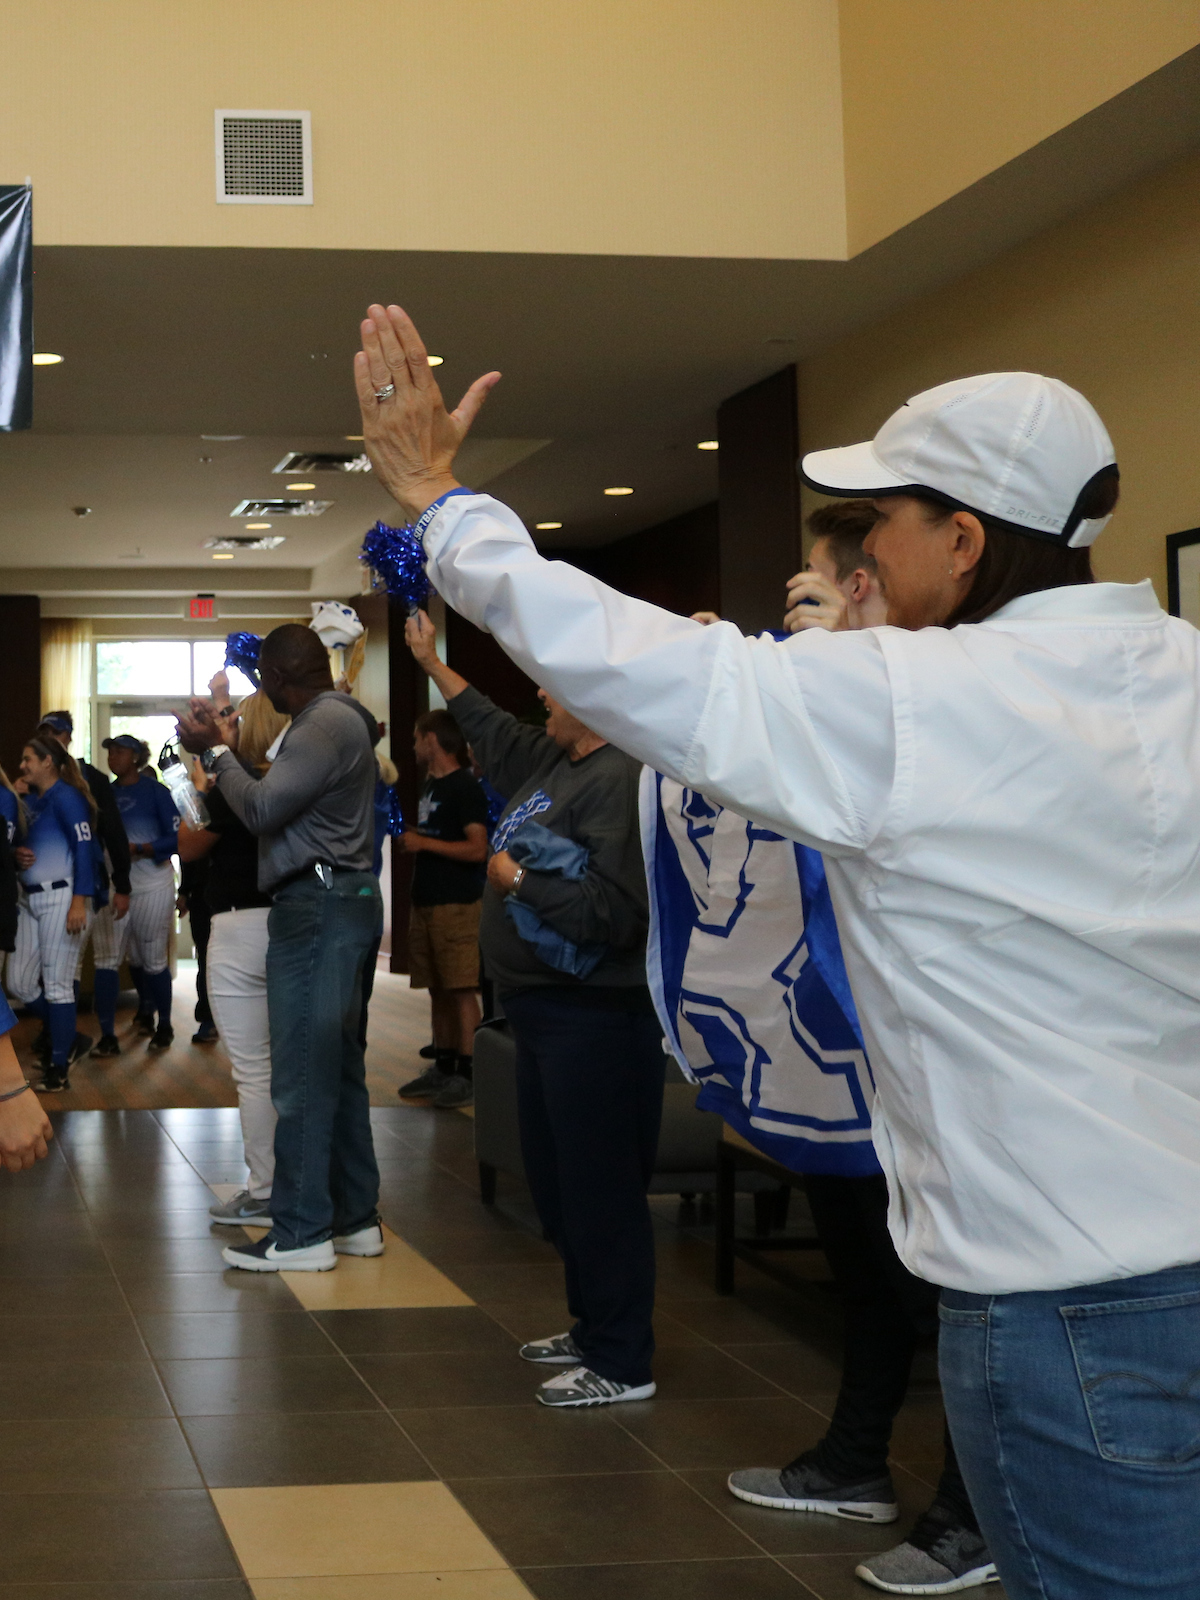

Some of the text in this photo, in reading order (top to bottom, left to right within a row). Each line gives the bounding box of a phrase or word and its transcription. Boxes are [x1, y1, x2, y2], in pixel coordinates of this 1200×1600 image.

[413, 503, 441, 540] SOFTBALL
[1006, 506, 1060, 527] DRI-FIT
[190, 599, 214, 618] EXIT
[74, 821, 92, 842] 19
